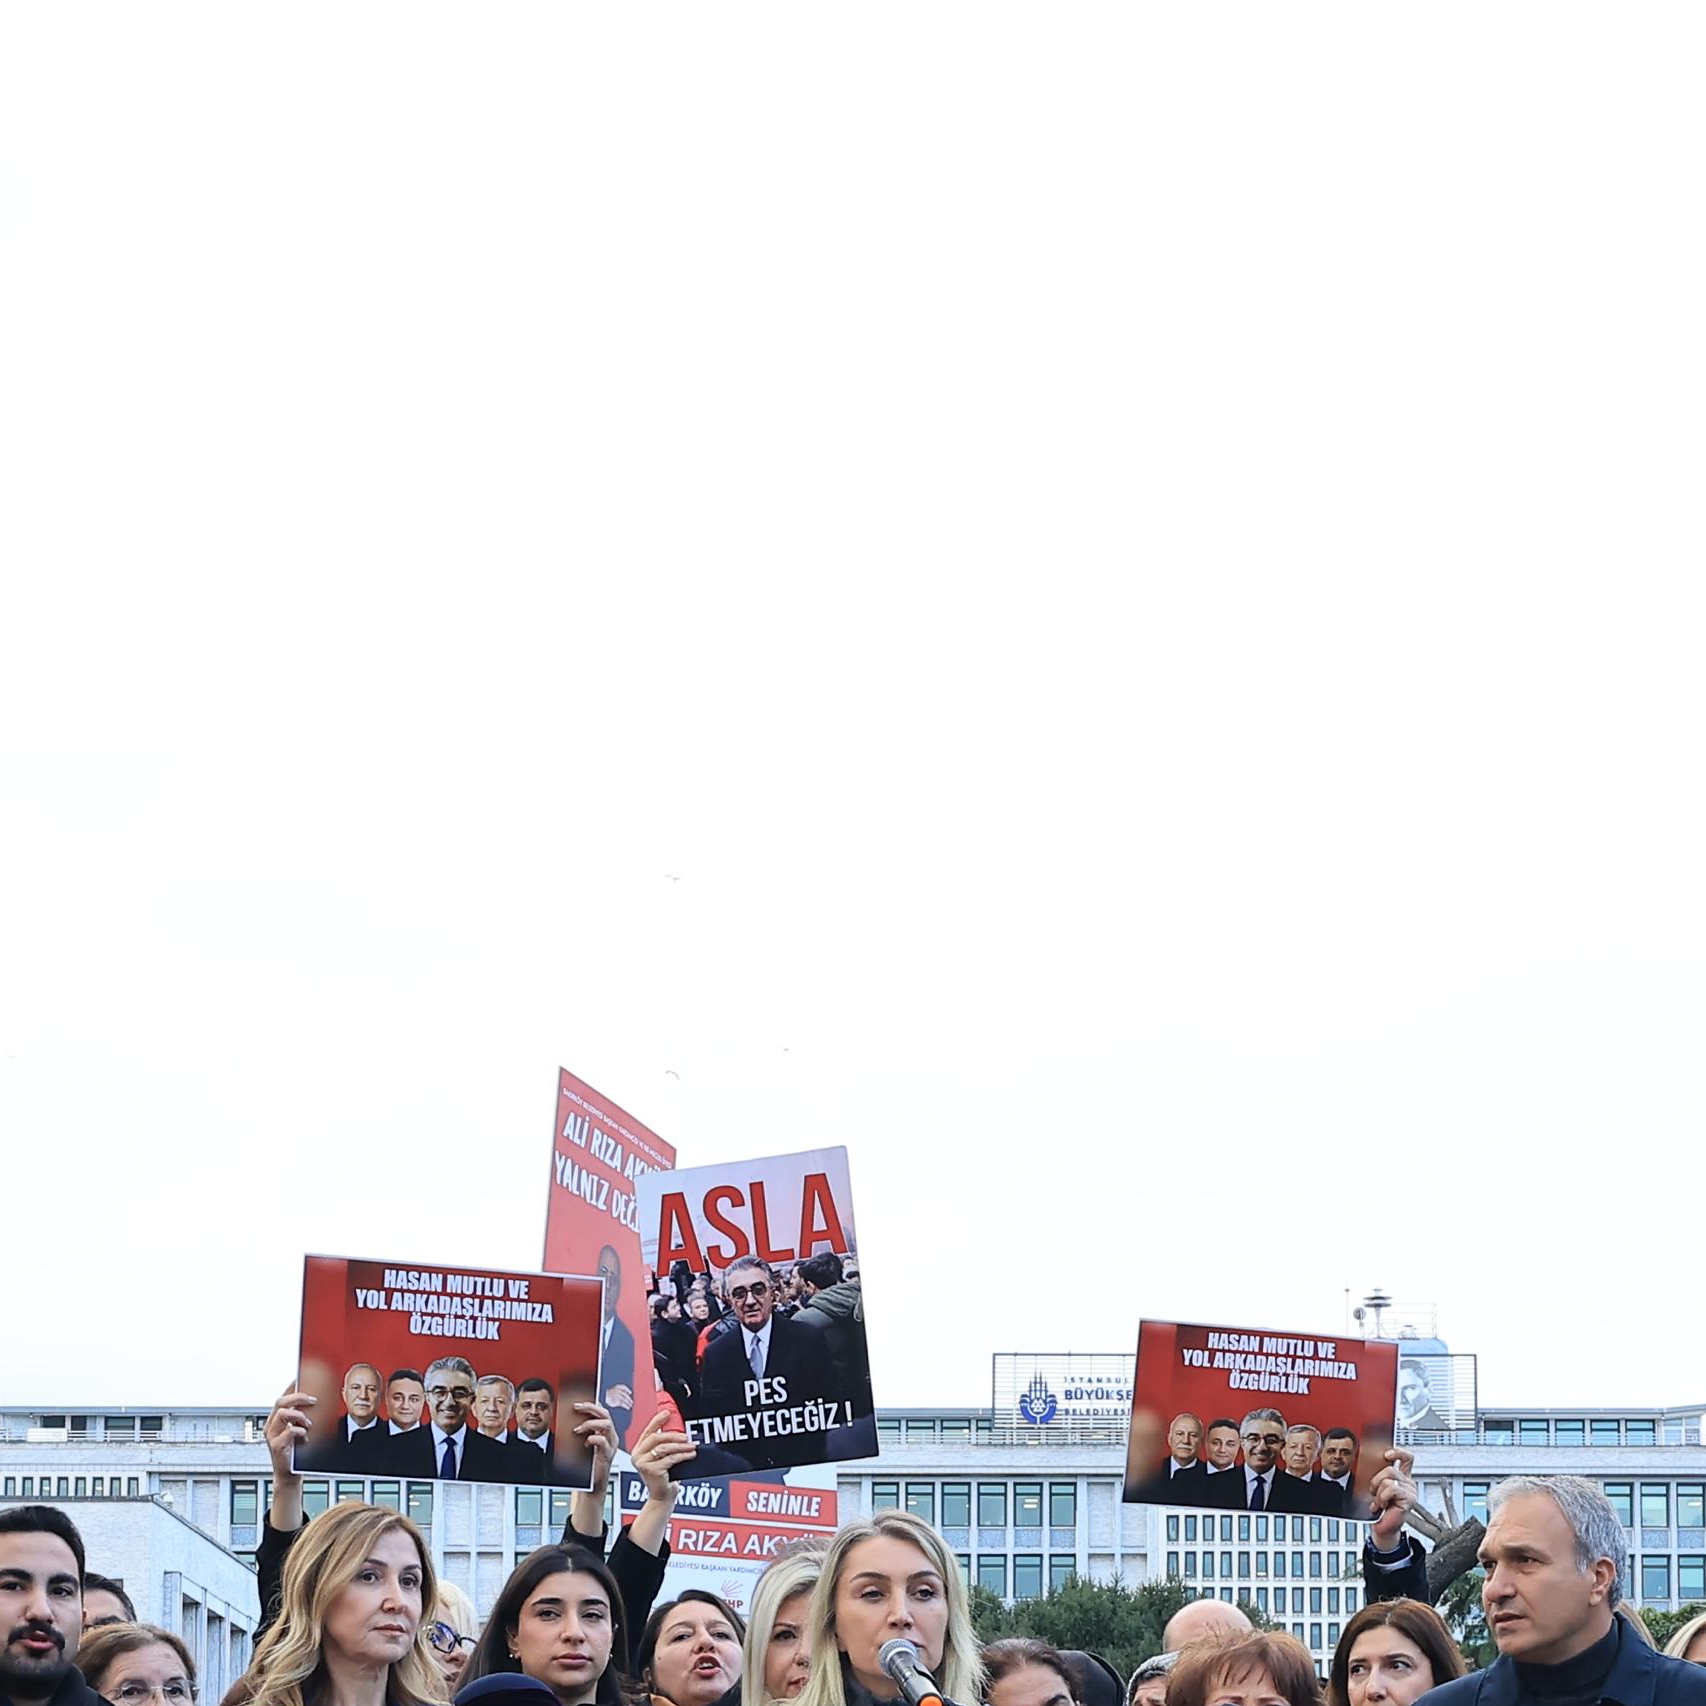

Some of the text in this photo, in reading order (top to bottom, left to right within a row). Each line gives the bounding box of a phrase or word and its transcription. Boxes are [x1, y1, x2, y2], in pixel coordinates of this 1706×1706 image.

[562, 1112, 590, 1148] ALİ
[590, 1128, 623, 1172] RIZA
[555, 1150, 611, 1211] YALNIZ
[656, 1172, 849, 1277] ASLA
[383, 1269, 529, 1299] HASAN MUTLU VE
[355, 1289, 553, 1323] YOL ARKADAŞLARIMIZA
[409, 1312, 499, 1340] ÖZGÜRLÜK
[1207, 1333, 1336, 1359] HASAN MUTLU VE
[1182, 1349, 1357, 1380] YOL ARKADAŞLARIMIZA
[744, 1376, 788, 1407] PES
[1064, 1387, 1133, 1401] BÜYÜKŞE
[1229, 1370, 1310, 1395] ÖZGÜRLÜK
[685, 1398, 841, 1446] ETMEYECEĞİZ
[628, 1481, 822, 1518] BARKÖY SENİNLE
[677, 1529, 738, 1554] RIZA
